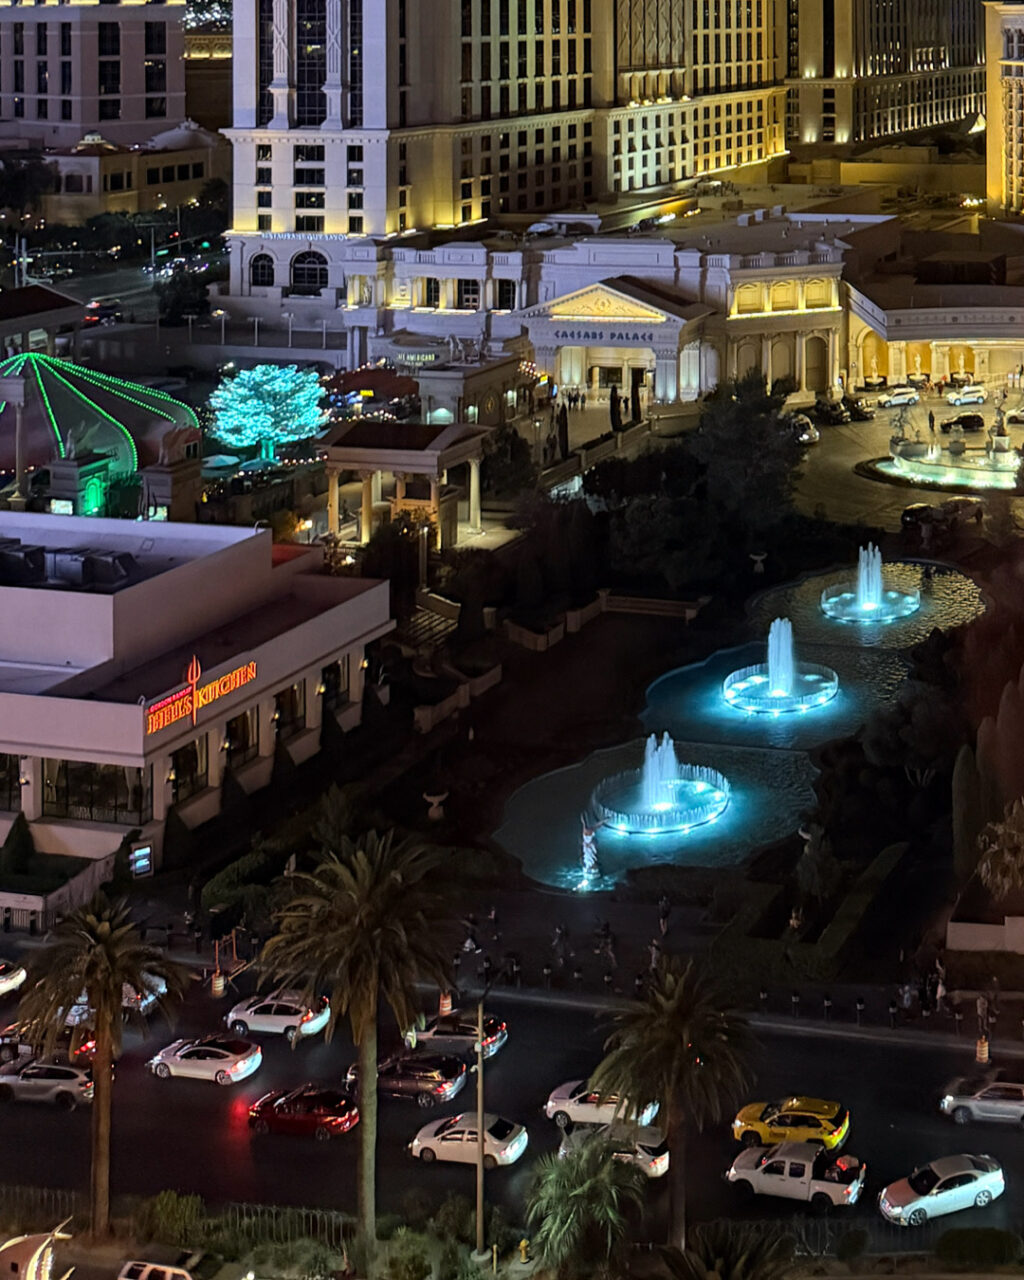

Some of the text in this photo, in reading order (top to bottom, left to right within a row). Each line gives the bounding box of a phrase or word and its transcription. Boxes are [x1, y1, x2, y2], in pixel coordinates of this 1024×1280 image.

[554, 330, 654, 341] CAESARS PALACE
[196, 661, 257, 709] KITCHEN
